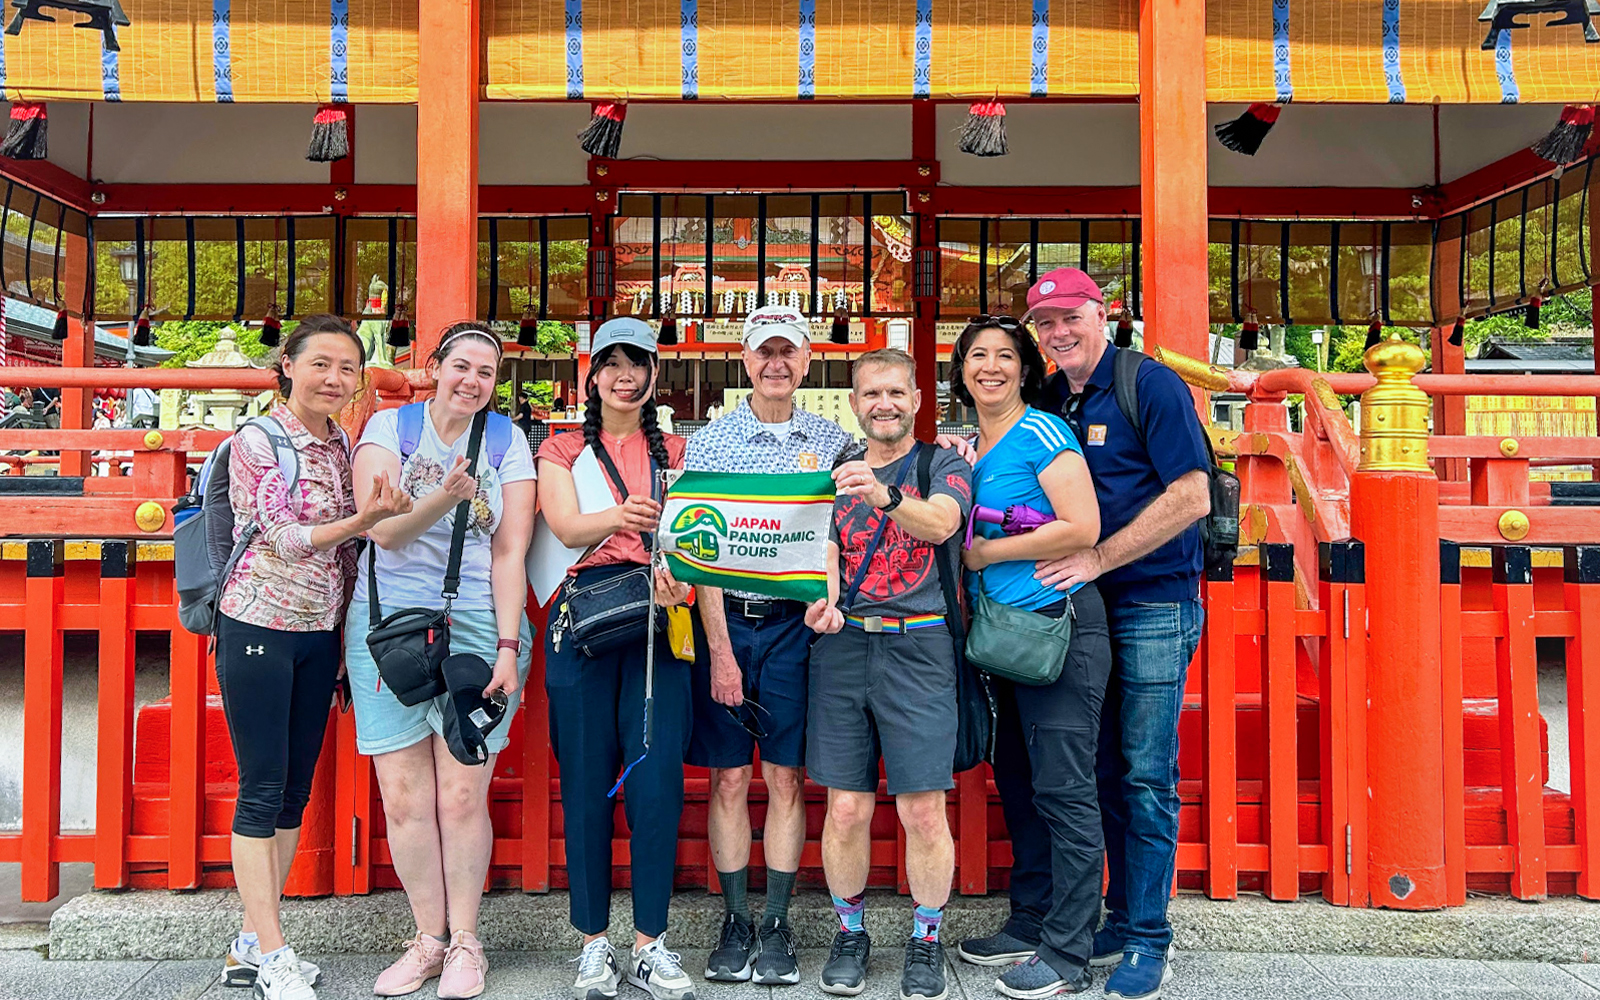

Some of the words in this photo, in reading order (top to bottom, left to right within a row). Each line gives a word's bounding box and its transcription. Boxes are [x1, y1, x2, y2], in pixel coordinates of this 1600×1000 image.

[730, 517, 781, 530] JAPAN
[729, 530, 815, 544] PANORAMIC
[728, 544, 778, 558] TOURS
